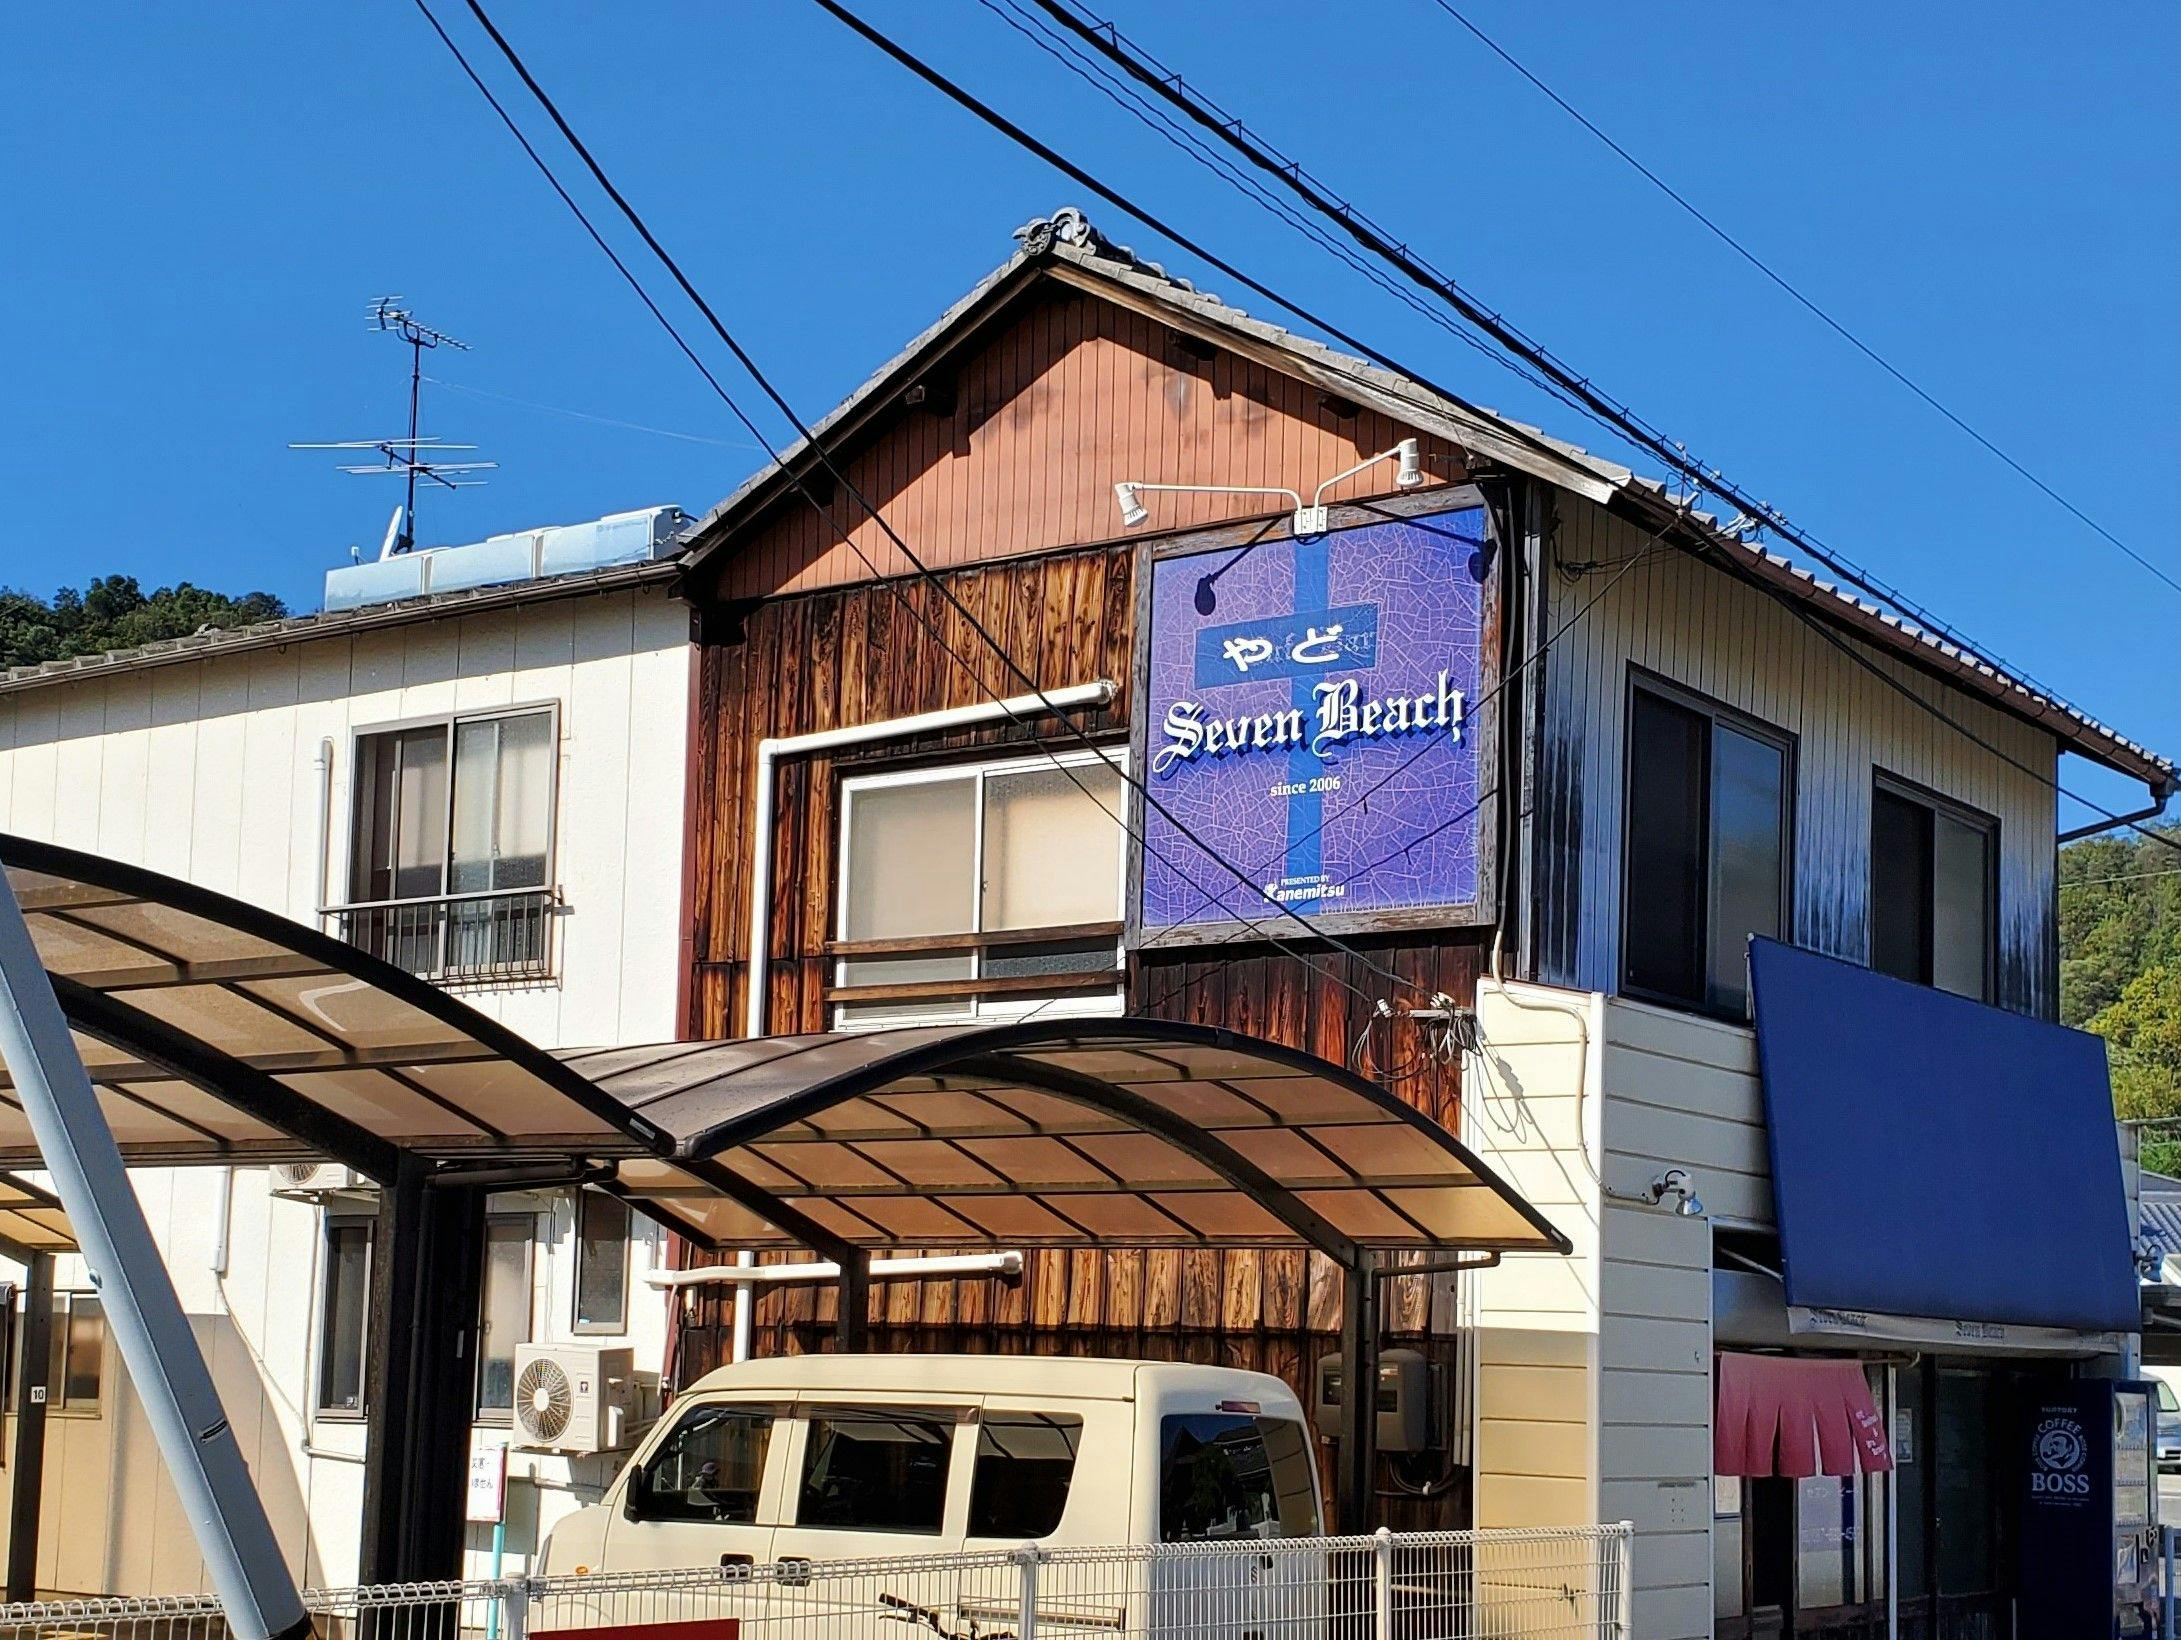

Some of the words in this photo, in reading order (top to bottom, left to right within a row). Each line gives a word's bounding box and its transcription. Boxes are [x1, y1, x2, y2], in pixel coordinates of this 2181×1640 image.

[1223, 624, 1343, 672] やど
[1152, 701, 1303, 774] Seven
[1312, 668, 1465, 757] Beach
[1270, 781, 1307, 797] since
[1309, 775, 1341, 793] 2006
[1280, 875, 1321, 886] PRESENTED
[1320, 874, 1330, 883] BY
[33, 1389, 44, 1400] 10
[2037, 1418, 2083, 1434] COFFEE
[2031, 1472, 2090, 1494] BOSS
